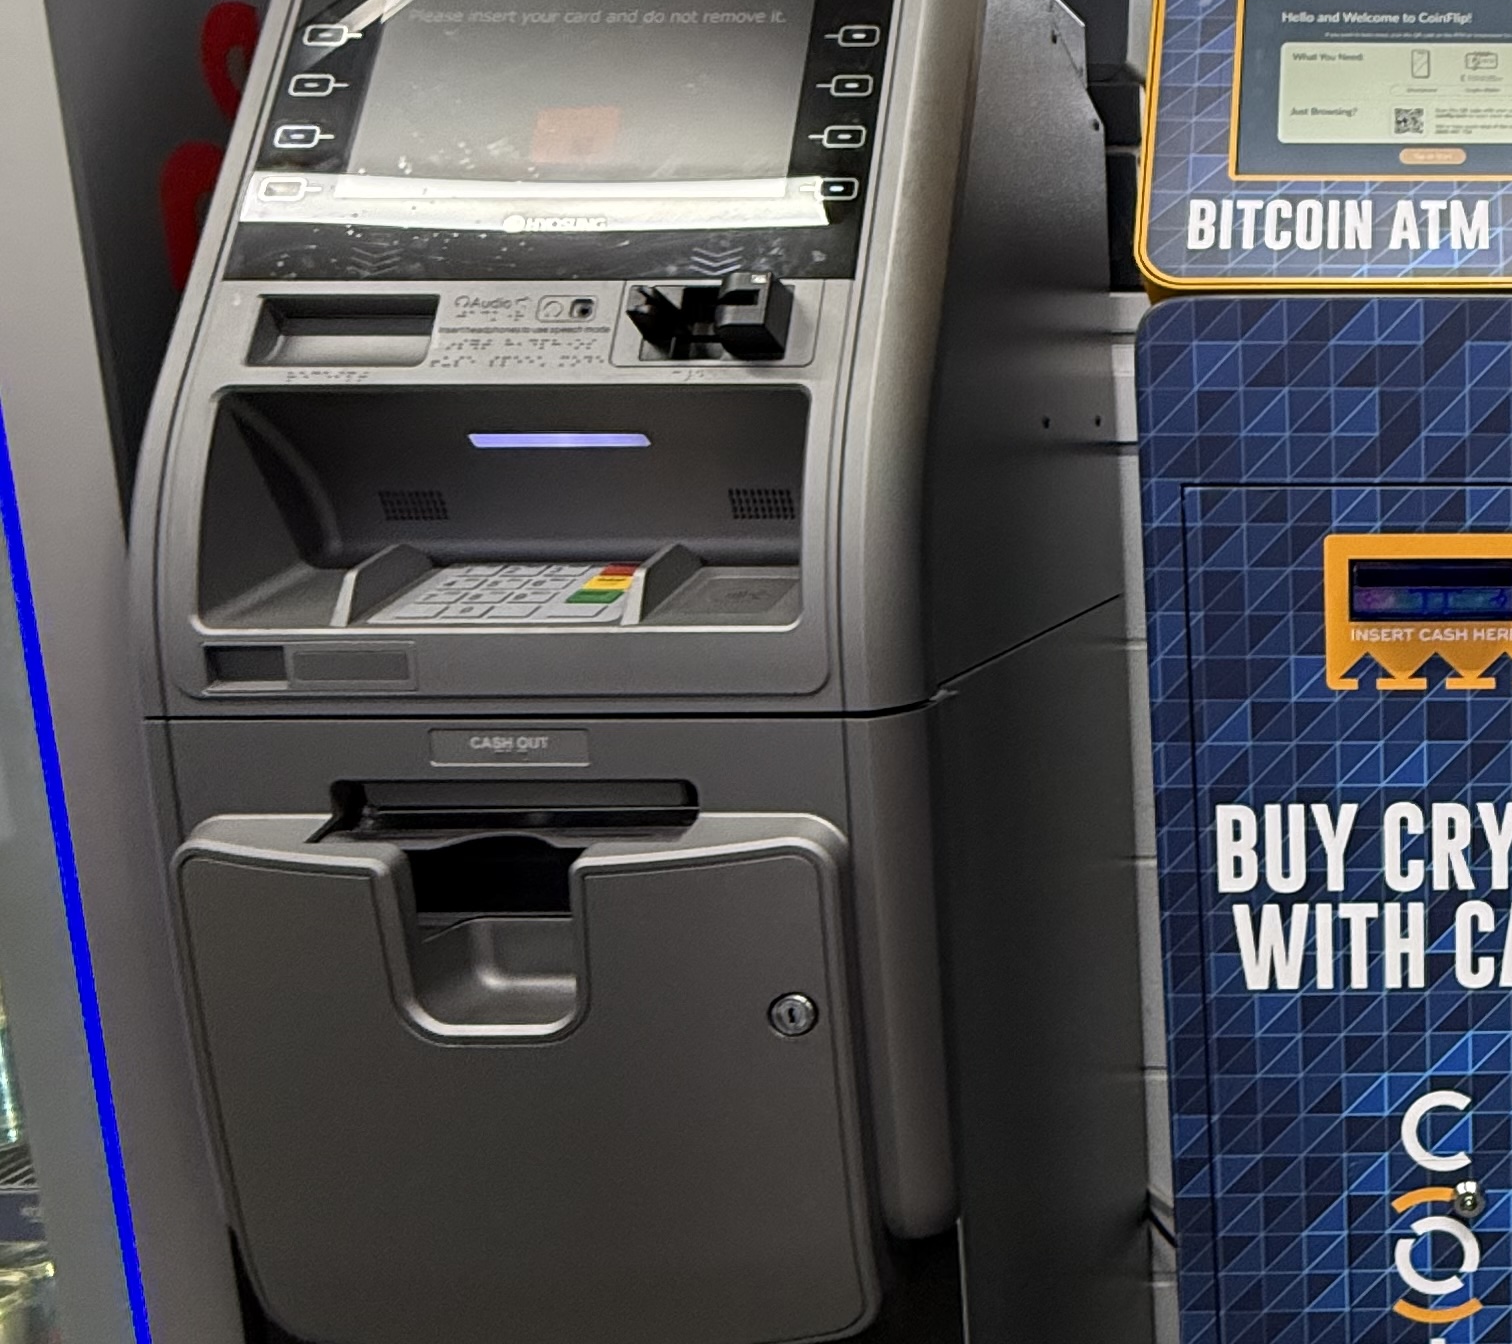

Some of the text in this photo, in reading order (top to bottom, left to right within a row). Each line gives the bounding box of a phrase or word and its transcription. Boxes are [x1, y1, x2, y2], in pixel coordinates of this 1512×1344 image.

[409, 9, 463, 23] Please
[468, 10, 516, 23] insert
[521, 11, 560, 25] your
[563, 9, 601, 23] card
[606, 9, 637, 24] and
[642, 9, 663, 24] do
[670, 10, 698, 24] not
[703, 13, 766, 24] remove
[1282, 12, 1473, 25] Hello and Welcome to CoinFlip!
[1187, 198, 1490, 251] BITCOIN ATM
[470, 297, 512, 310] Audio
[1350, 627, 1415, 642] INSERT
[1418, 627, 1469, 641] CASH
[469, 736, 549, 750] CASH OUT
[1215, 802, 1359, 894] BUY
[1232, 900, 1426, 991] WITH
